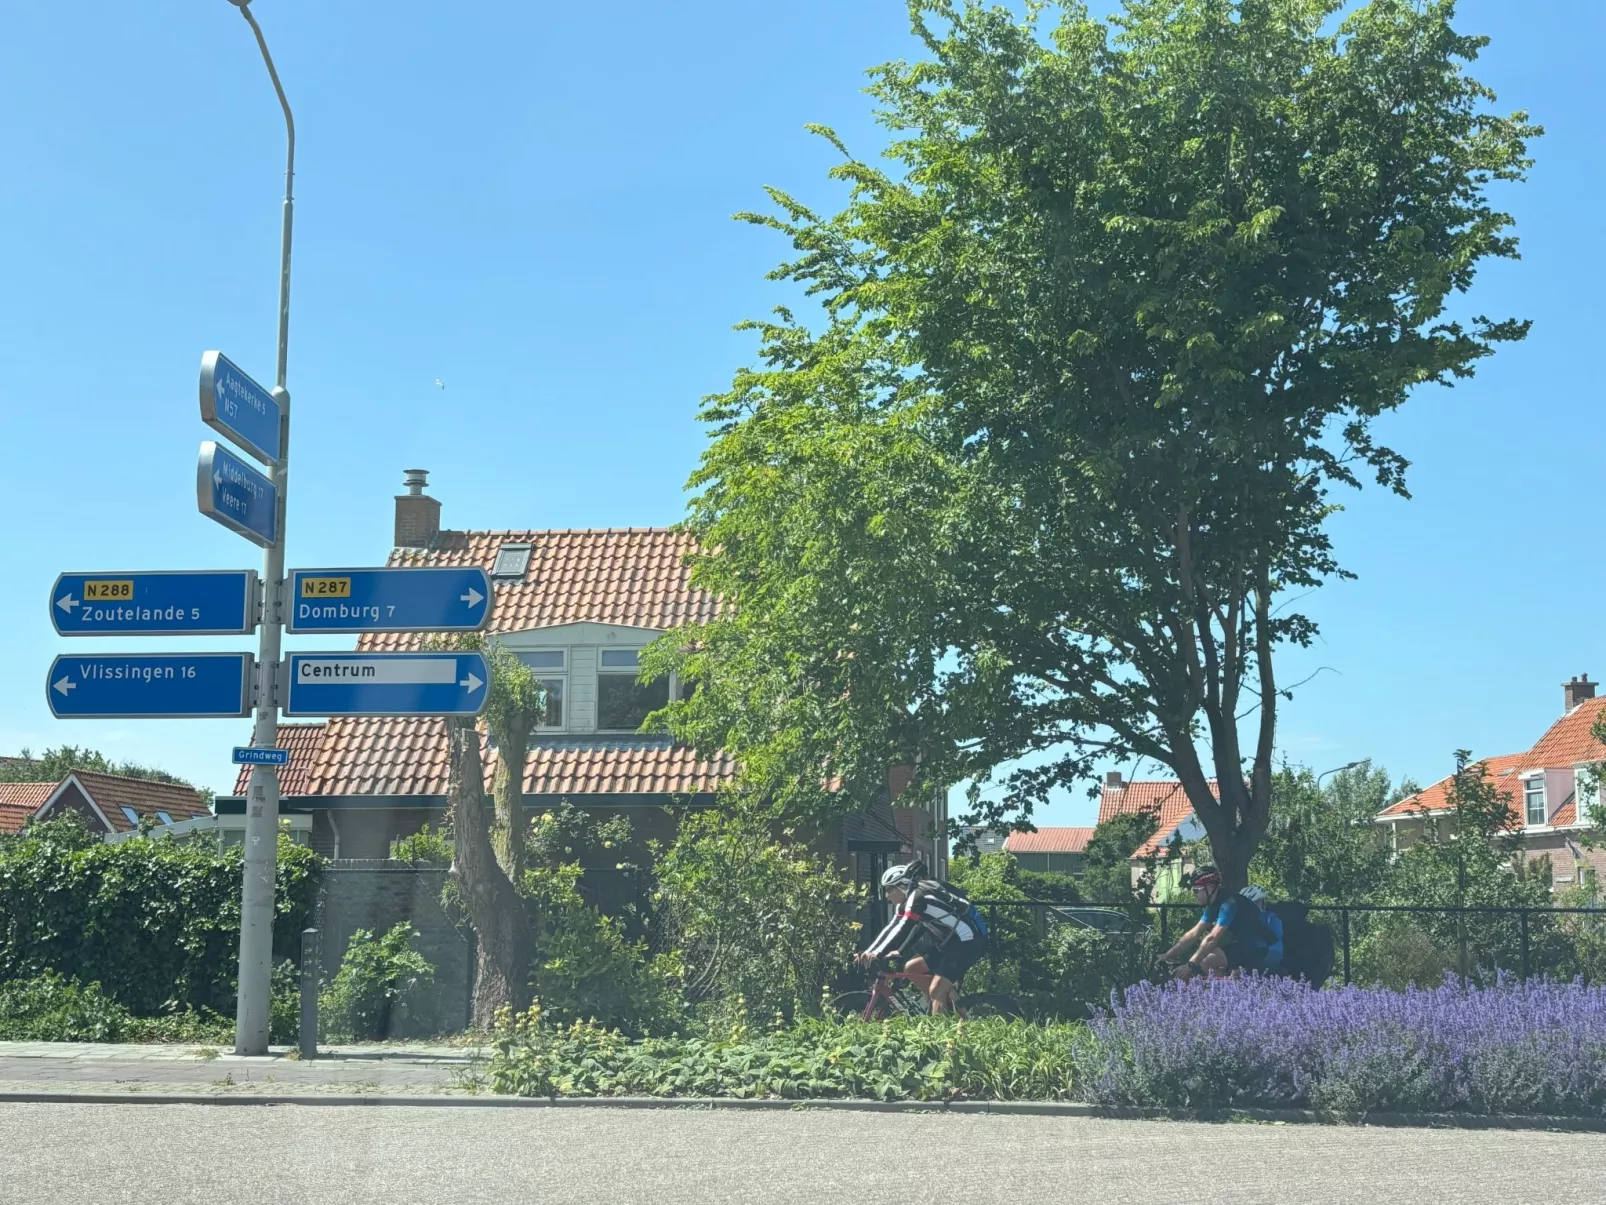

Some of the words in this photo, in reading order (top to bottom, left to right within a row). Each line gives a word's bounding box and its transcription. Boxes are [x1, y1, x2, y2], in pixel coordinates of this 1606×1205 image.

[224, 397, 239, 420] N57
[222, 487, 240, 511] Veere
[81, 605, 185, 621] Zoutelande
[191, 608, 200, 620] 5
[299, 604, 380, 622] Domburg
[386, 605, 396, 618] 7
[80, 664, 174, 683] Vlissingen
[181, 666, 196, 678] 16
[301, 663, 376, 677] Centrum
[238, 750, 282, 762] Grindweg
